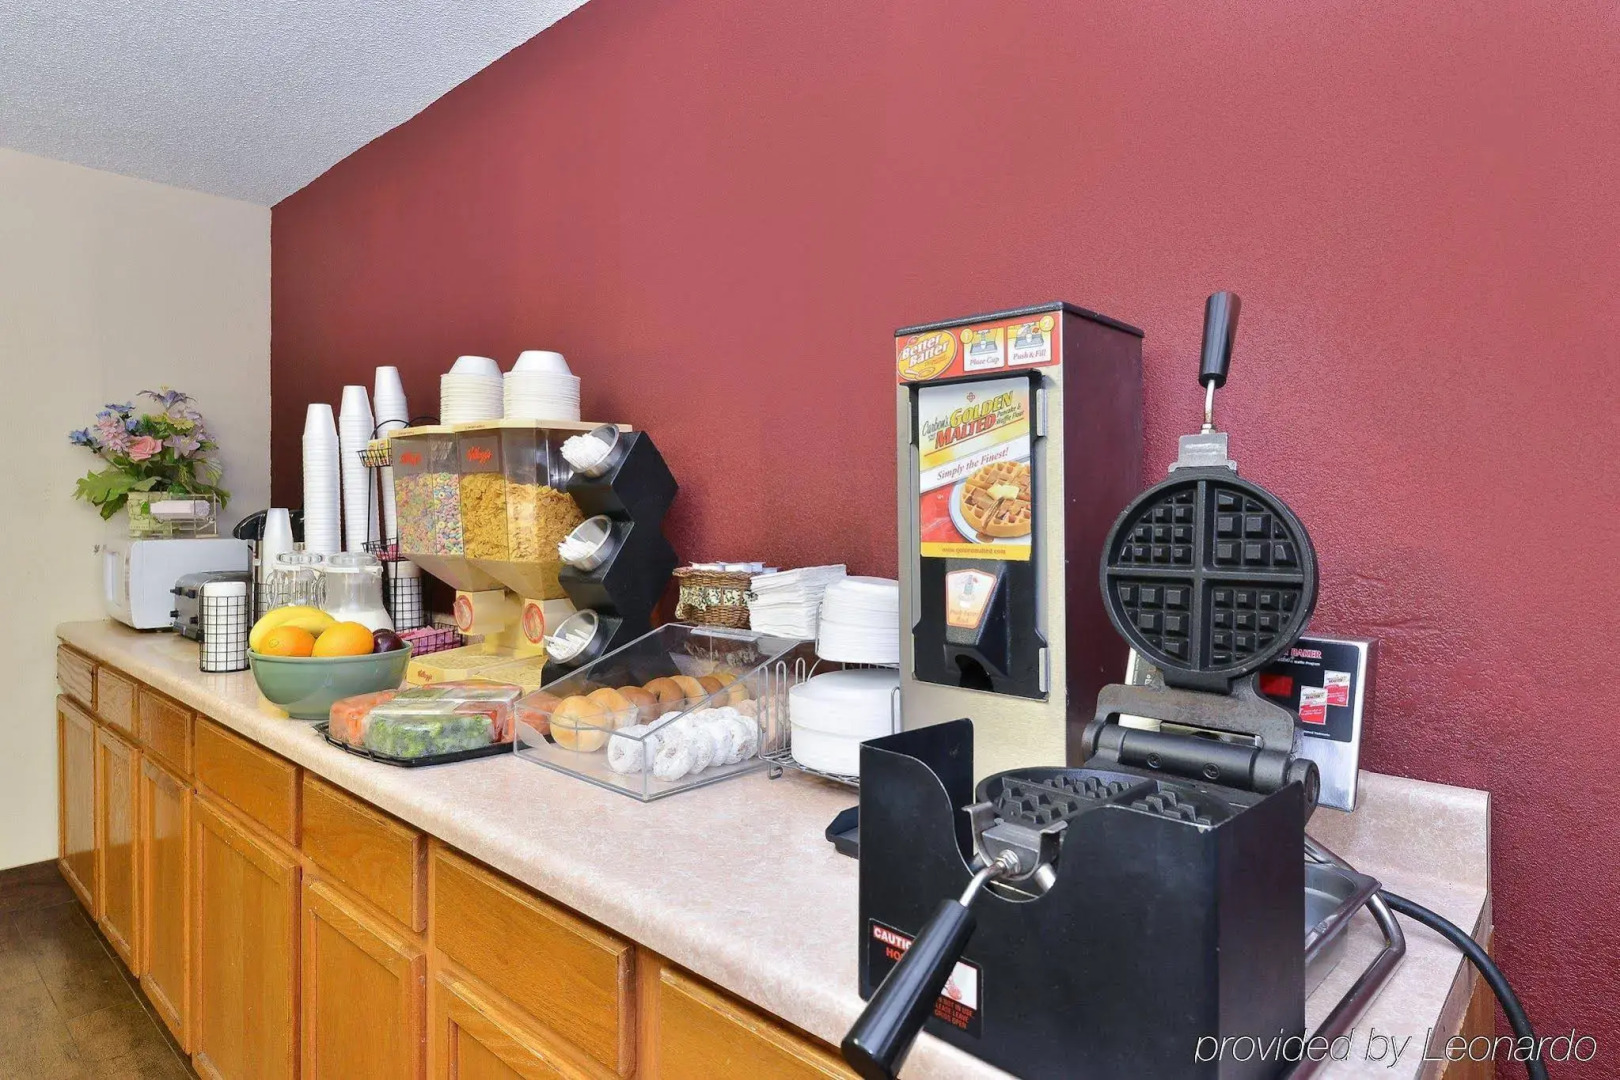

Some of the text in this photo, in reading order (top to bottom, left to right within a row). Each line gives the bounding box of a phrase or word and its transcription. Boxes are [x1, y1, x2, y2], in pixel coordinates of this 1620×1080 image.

[902, 335, 942, 359] Better
[909, 341, 949, 367] Batter
[1013, 352, 1028, 360] Push
[1035, 350, 1047, 358] Fill
[970, 356, 1000, 366] Place Cup
[950, 391, 1014, 428] GOLDEN
[935, 413, 996, 449] MALTED
[937, 447, 1009, 480] Simply the Finest!
[1291, 648, 1322, 659] BAKER
[873, 926, 913, 950] CAUTIO
[886, 947, 904, 962] HO
